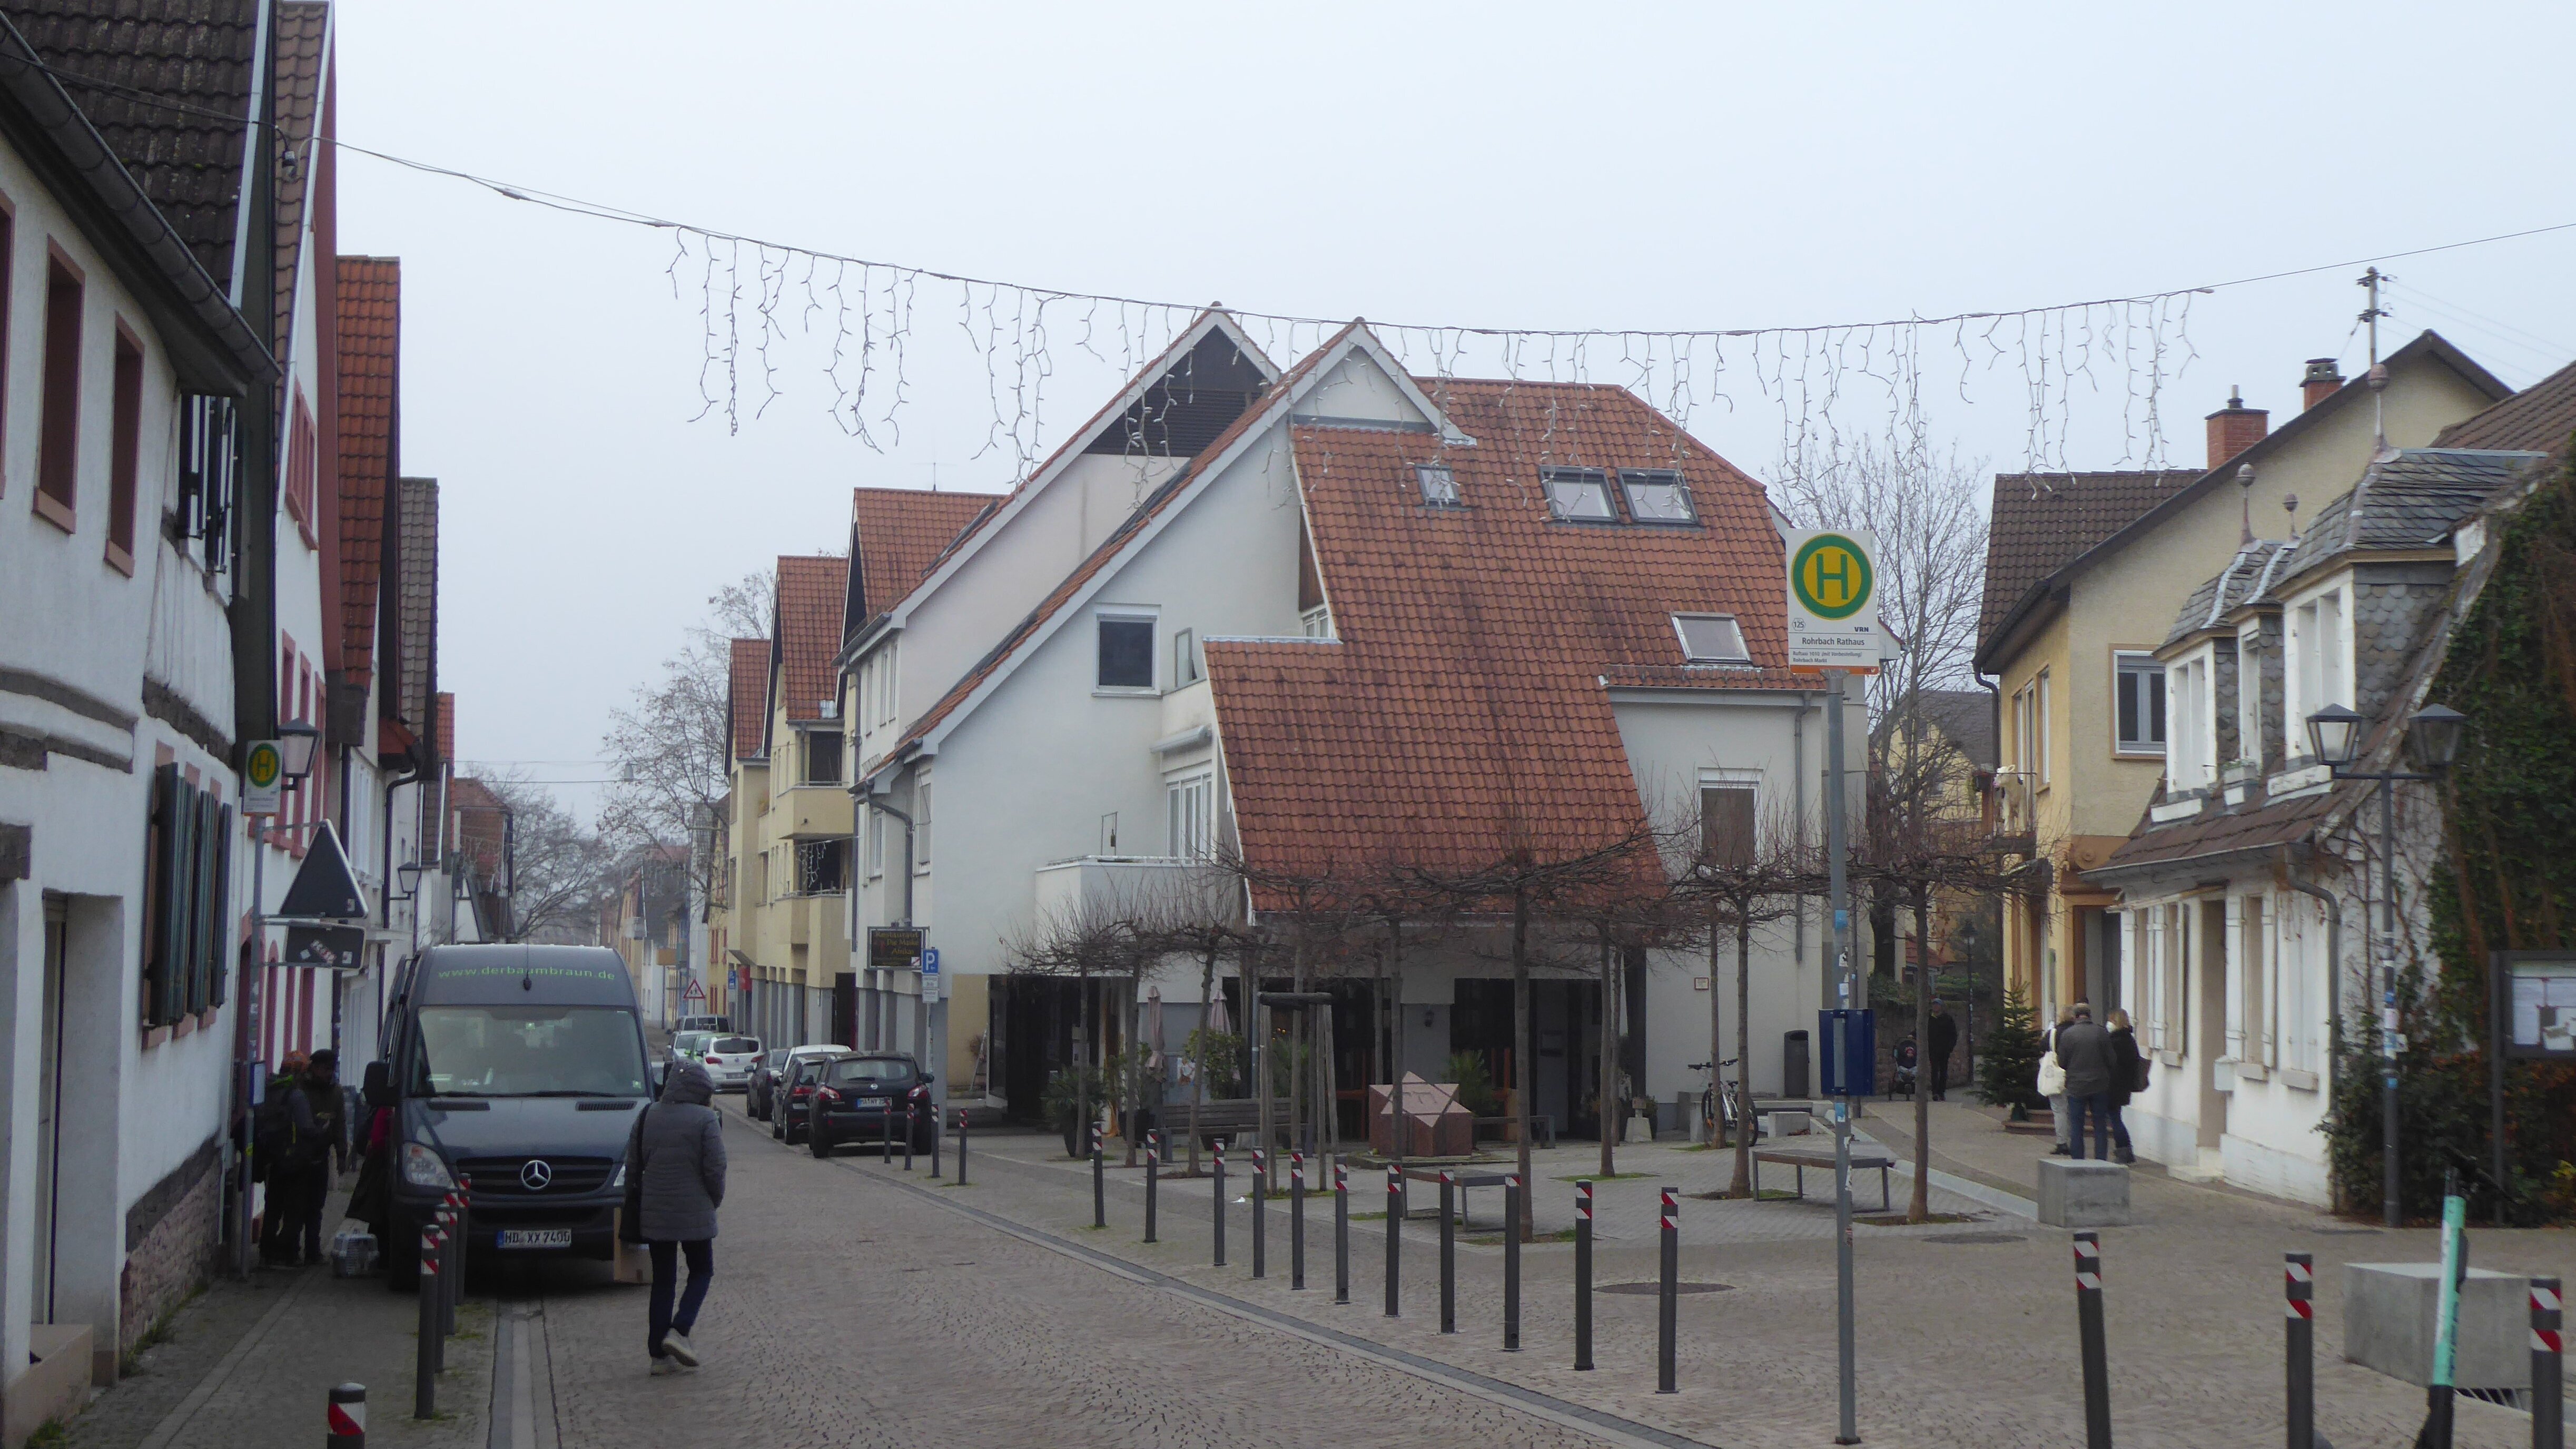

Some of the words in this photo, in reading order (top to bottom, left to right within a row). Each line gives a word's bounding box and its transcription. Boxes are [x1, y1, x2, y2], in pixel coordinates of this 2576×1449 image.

[1816, 554, 1849, 599] H
[257, 754, 270, 777] H
[926, 952, 935, 971] P
[505, 1231, 519, 1244] HD
[527, 1231, 540, 1244] XX
